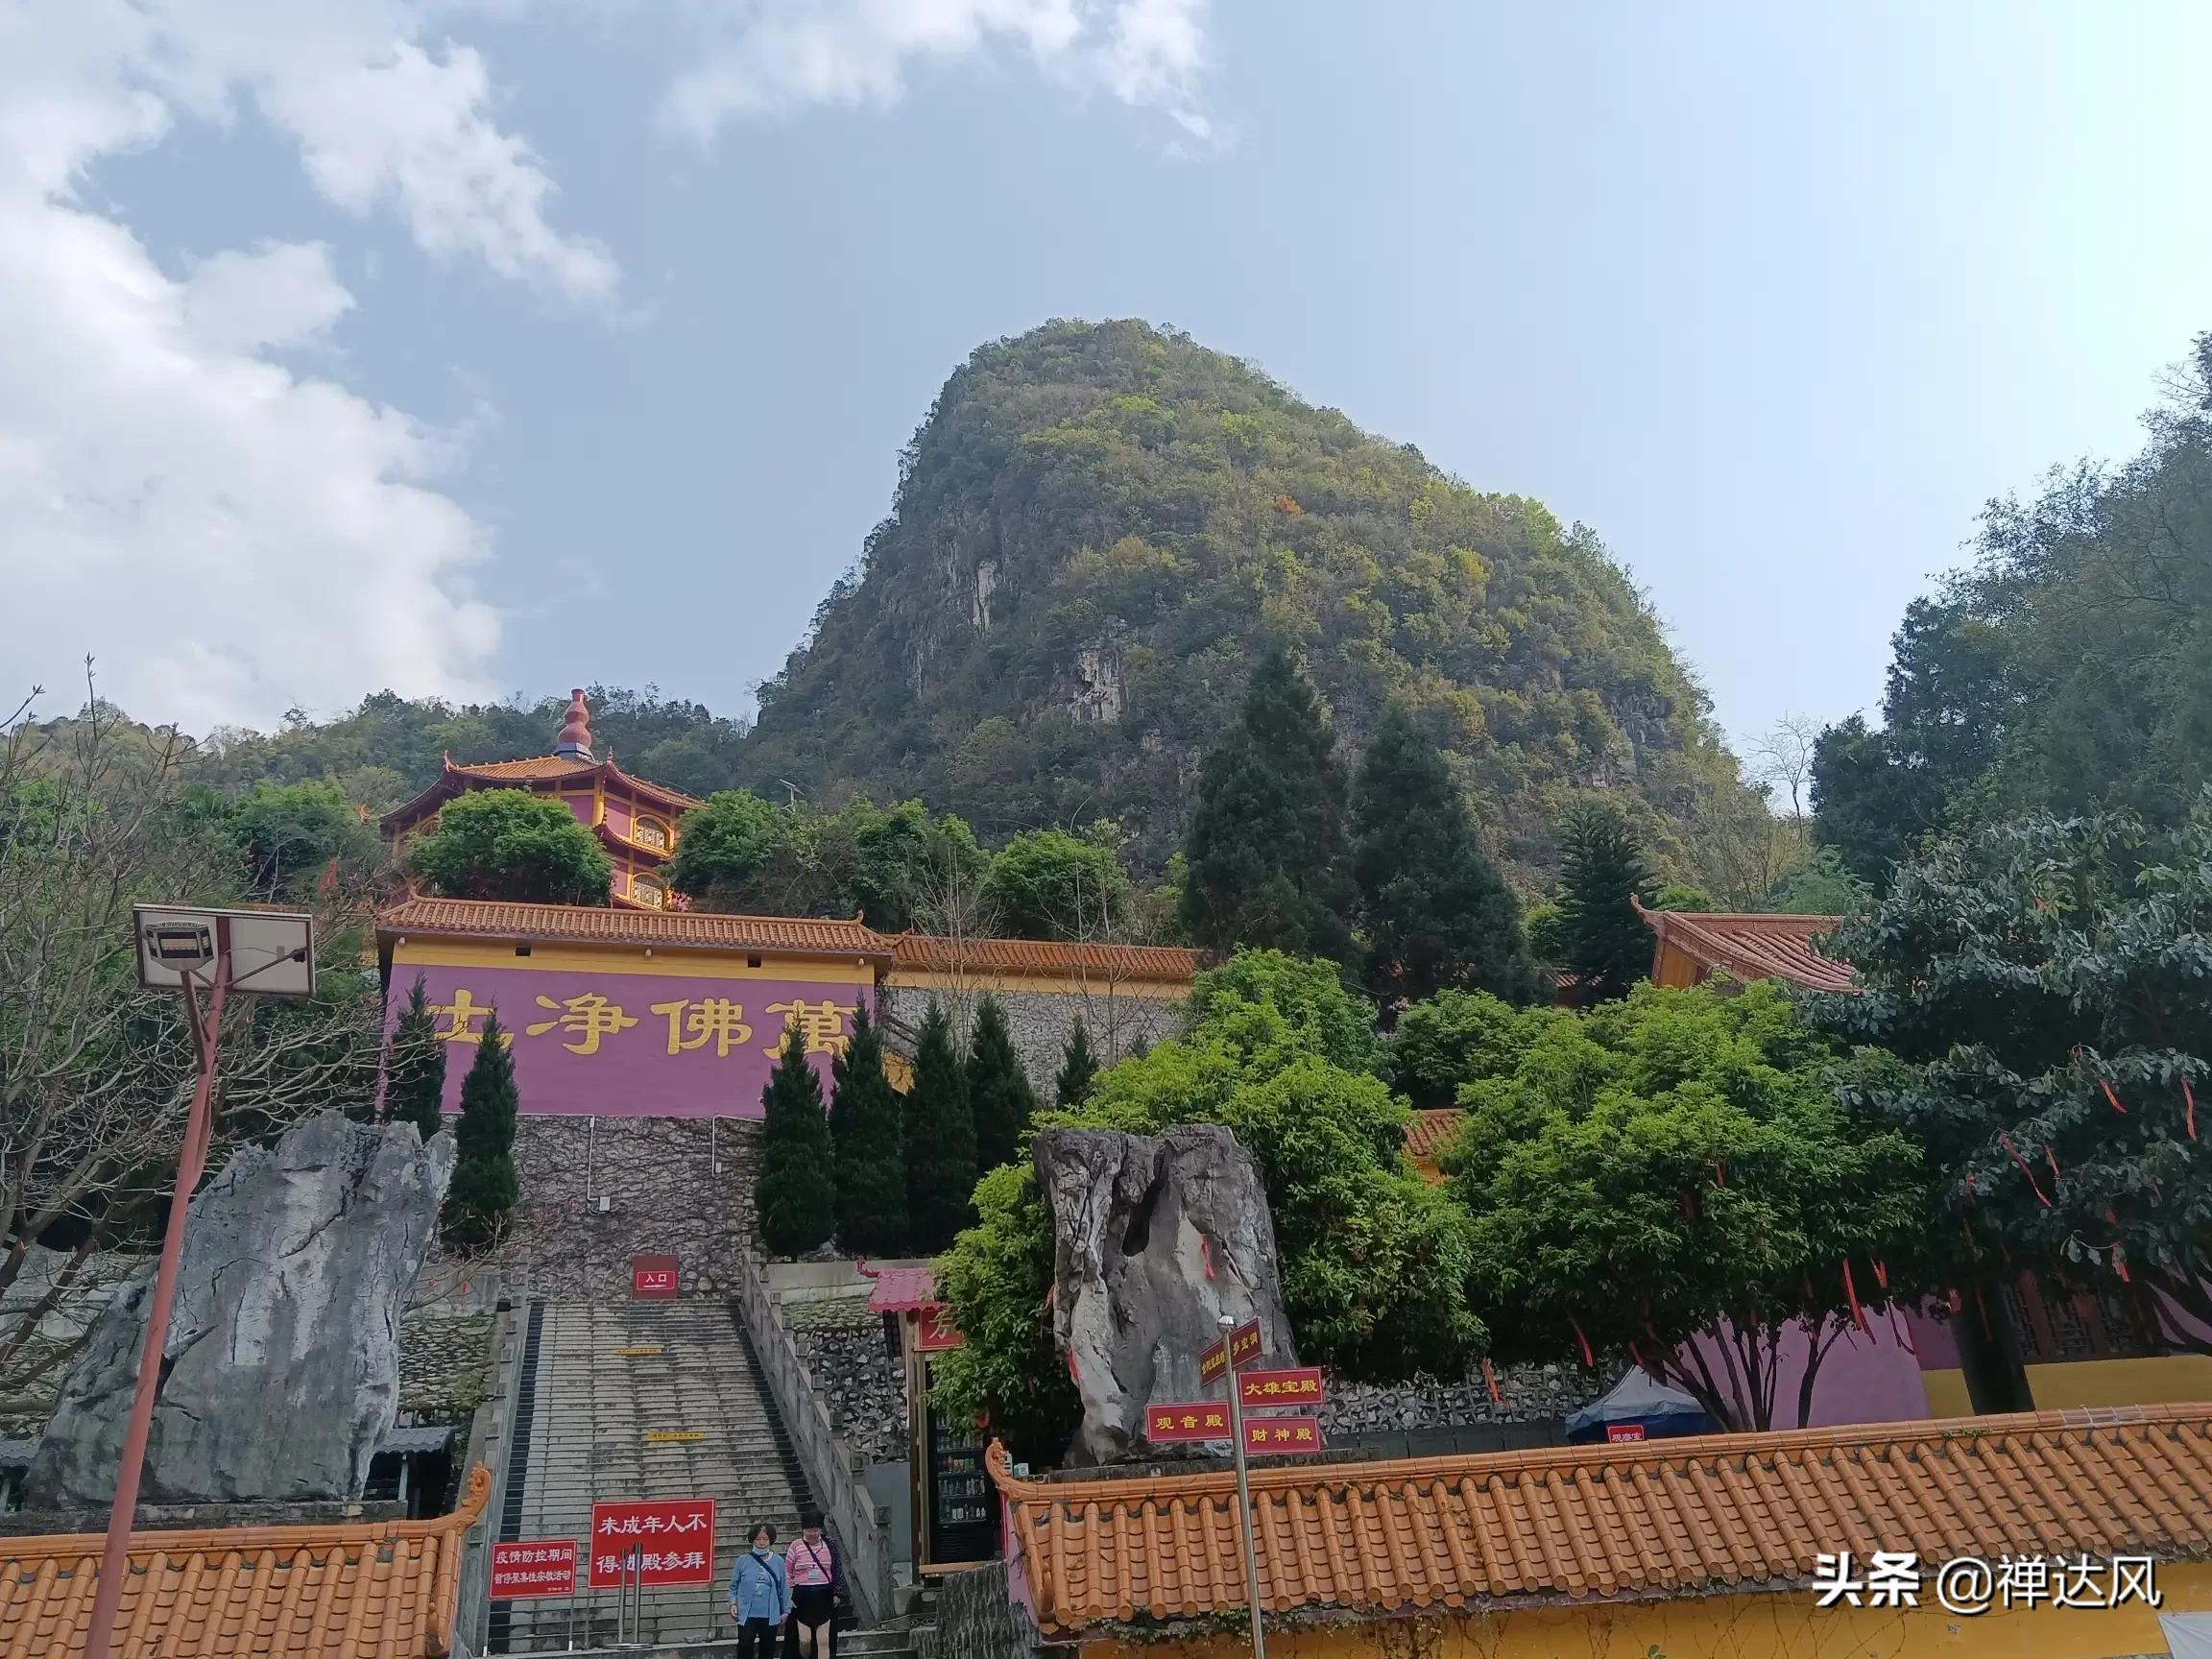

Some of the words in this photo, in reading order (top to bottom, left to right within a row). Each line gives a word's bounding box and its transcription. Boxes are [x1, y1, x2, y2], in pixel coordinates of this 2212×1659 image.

[646, 1274, 667, 1283] 入口
[1244, 1380, 1318, 1396] 大雄宝殿
[1156, 1413, 1224, 1431] 观音殿
[1251, 1428, 1313, 1442] 财神殿
[598, 1513, 708, 1536] 未成年人不
[494, 1548, 573, 1564] 疫情防控期间
[494, 1570, 571, 1585] 暂停聚集性宗教活动
